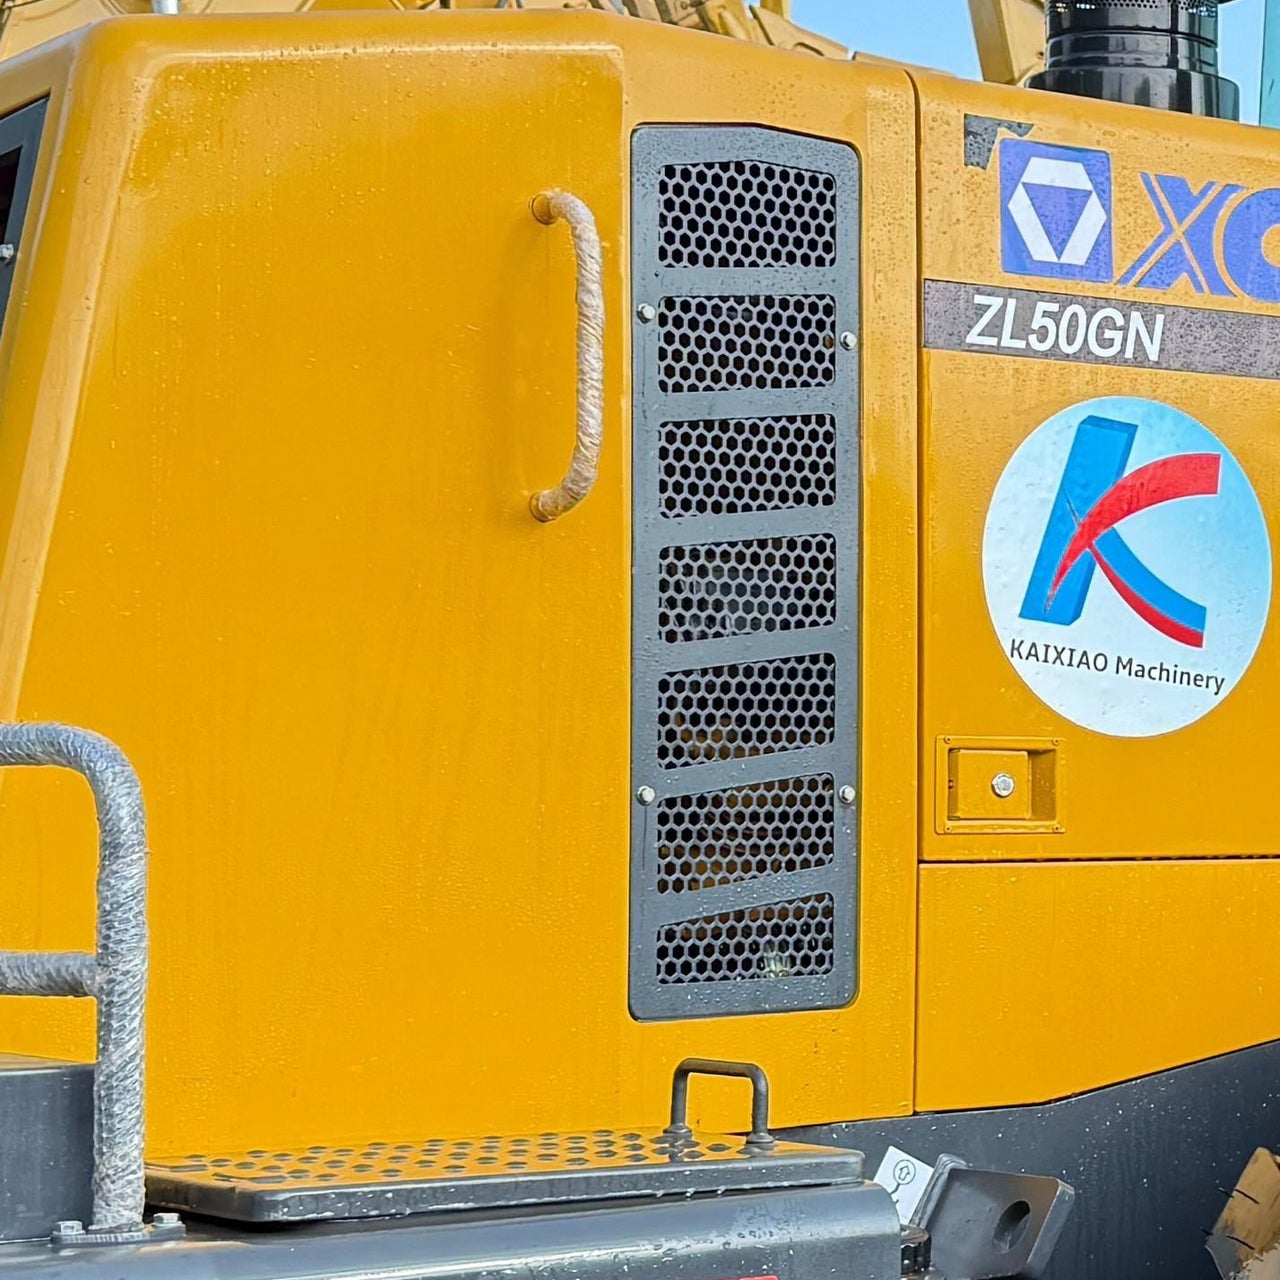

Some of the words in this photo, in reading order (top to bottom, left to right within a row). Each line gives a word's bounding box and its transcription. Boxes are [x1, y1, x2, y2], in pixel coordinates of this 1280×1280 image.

[965, 294, 1165, 363] ZL50GN
[1009, 637, 1109, 674] KAIXIAO
[1114, 655, 1226, 697] Machinery
